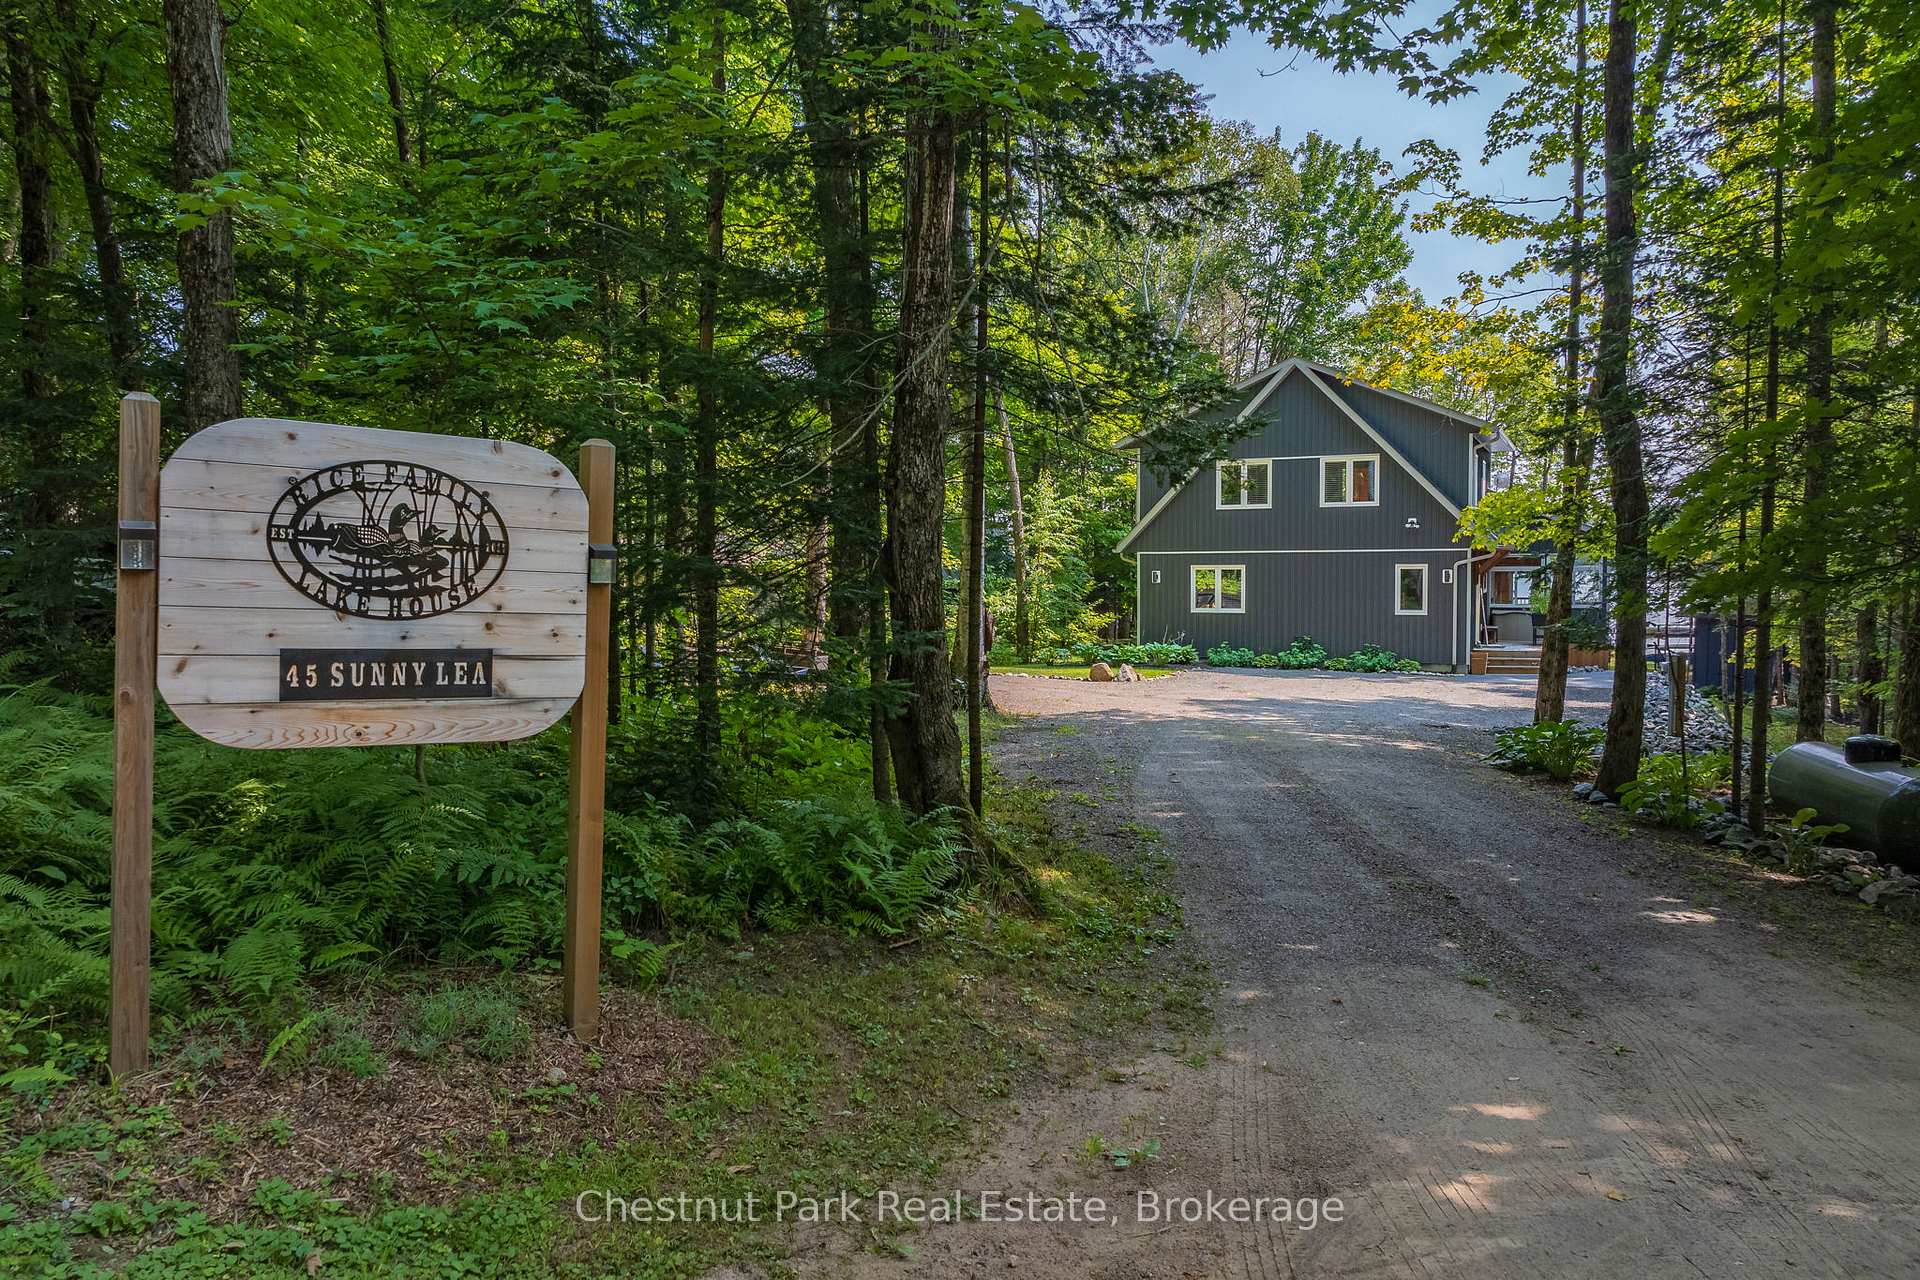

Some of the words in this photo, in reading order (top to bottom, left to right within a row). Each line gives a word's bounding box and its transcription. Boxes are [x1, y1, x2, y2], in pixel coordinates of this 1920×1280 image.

[289, 464, 365, 507] RICE
[385, 464, 491, 517] FAMILY
[270, 527, 295, 539] EST
[295, 571, 370, 612] LAKE
[388, 575, 478, 617] HOUSE
[286, 664, 318, 688] 45
[330, 662, 426, 688] SUNNY
[435, 661, 487, 686] LEA
